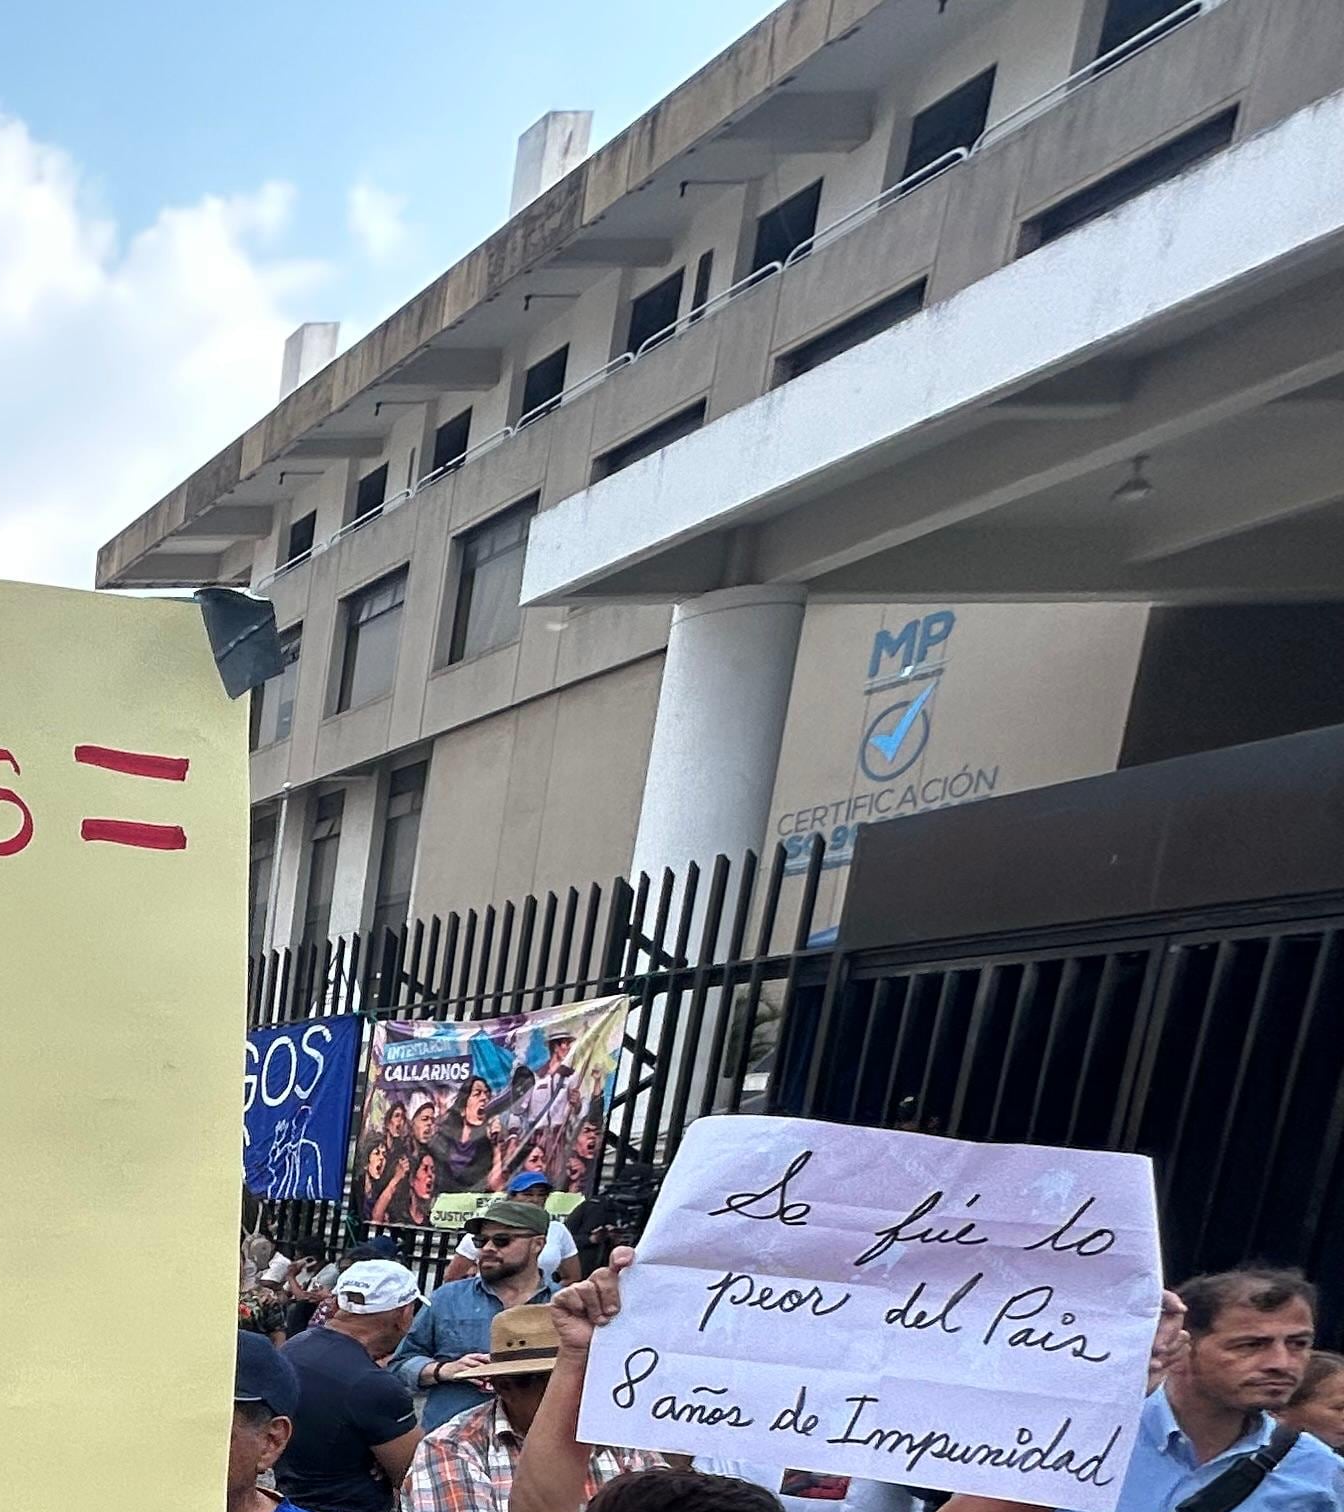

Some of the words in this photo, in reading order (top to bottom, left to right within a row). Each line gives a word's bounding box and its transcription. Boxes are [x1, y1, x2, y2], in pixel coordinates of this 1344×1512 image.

[868, 610, 956, 678] MP
[777, 764, 999, 837] CERTIFICACIÓN
[384, 1061, 471, 1082] CALLARNOS
[708, 1150, 813, 1226] Se
[853, 1191, 988, 1267] fué
[1024, 1197, 1115, 1257] lo
[699, 1272, 851, 1332] peor
[885, 1272, 984, 1333] del
[612, 1347, 659, 1409] 8
[651, 1386, 753, 1428] años
[769, 1385, 819, 1436] de
[826, 1395, 1122, 1488] Impunidad
